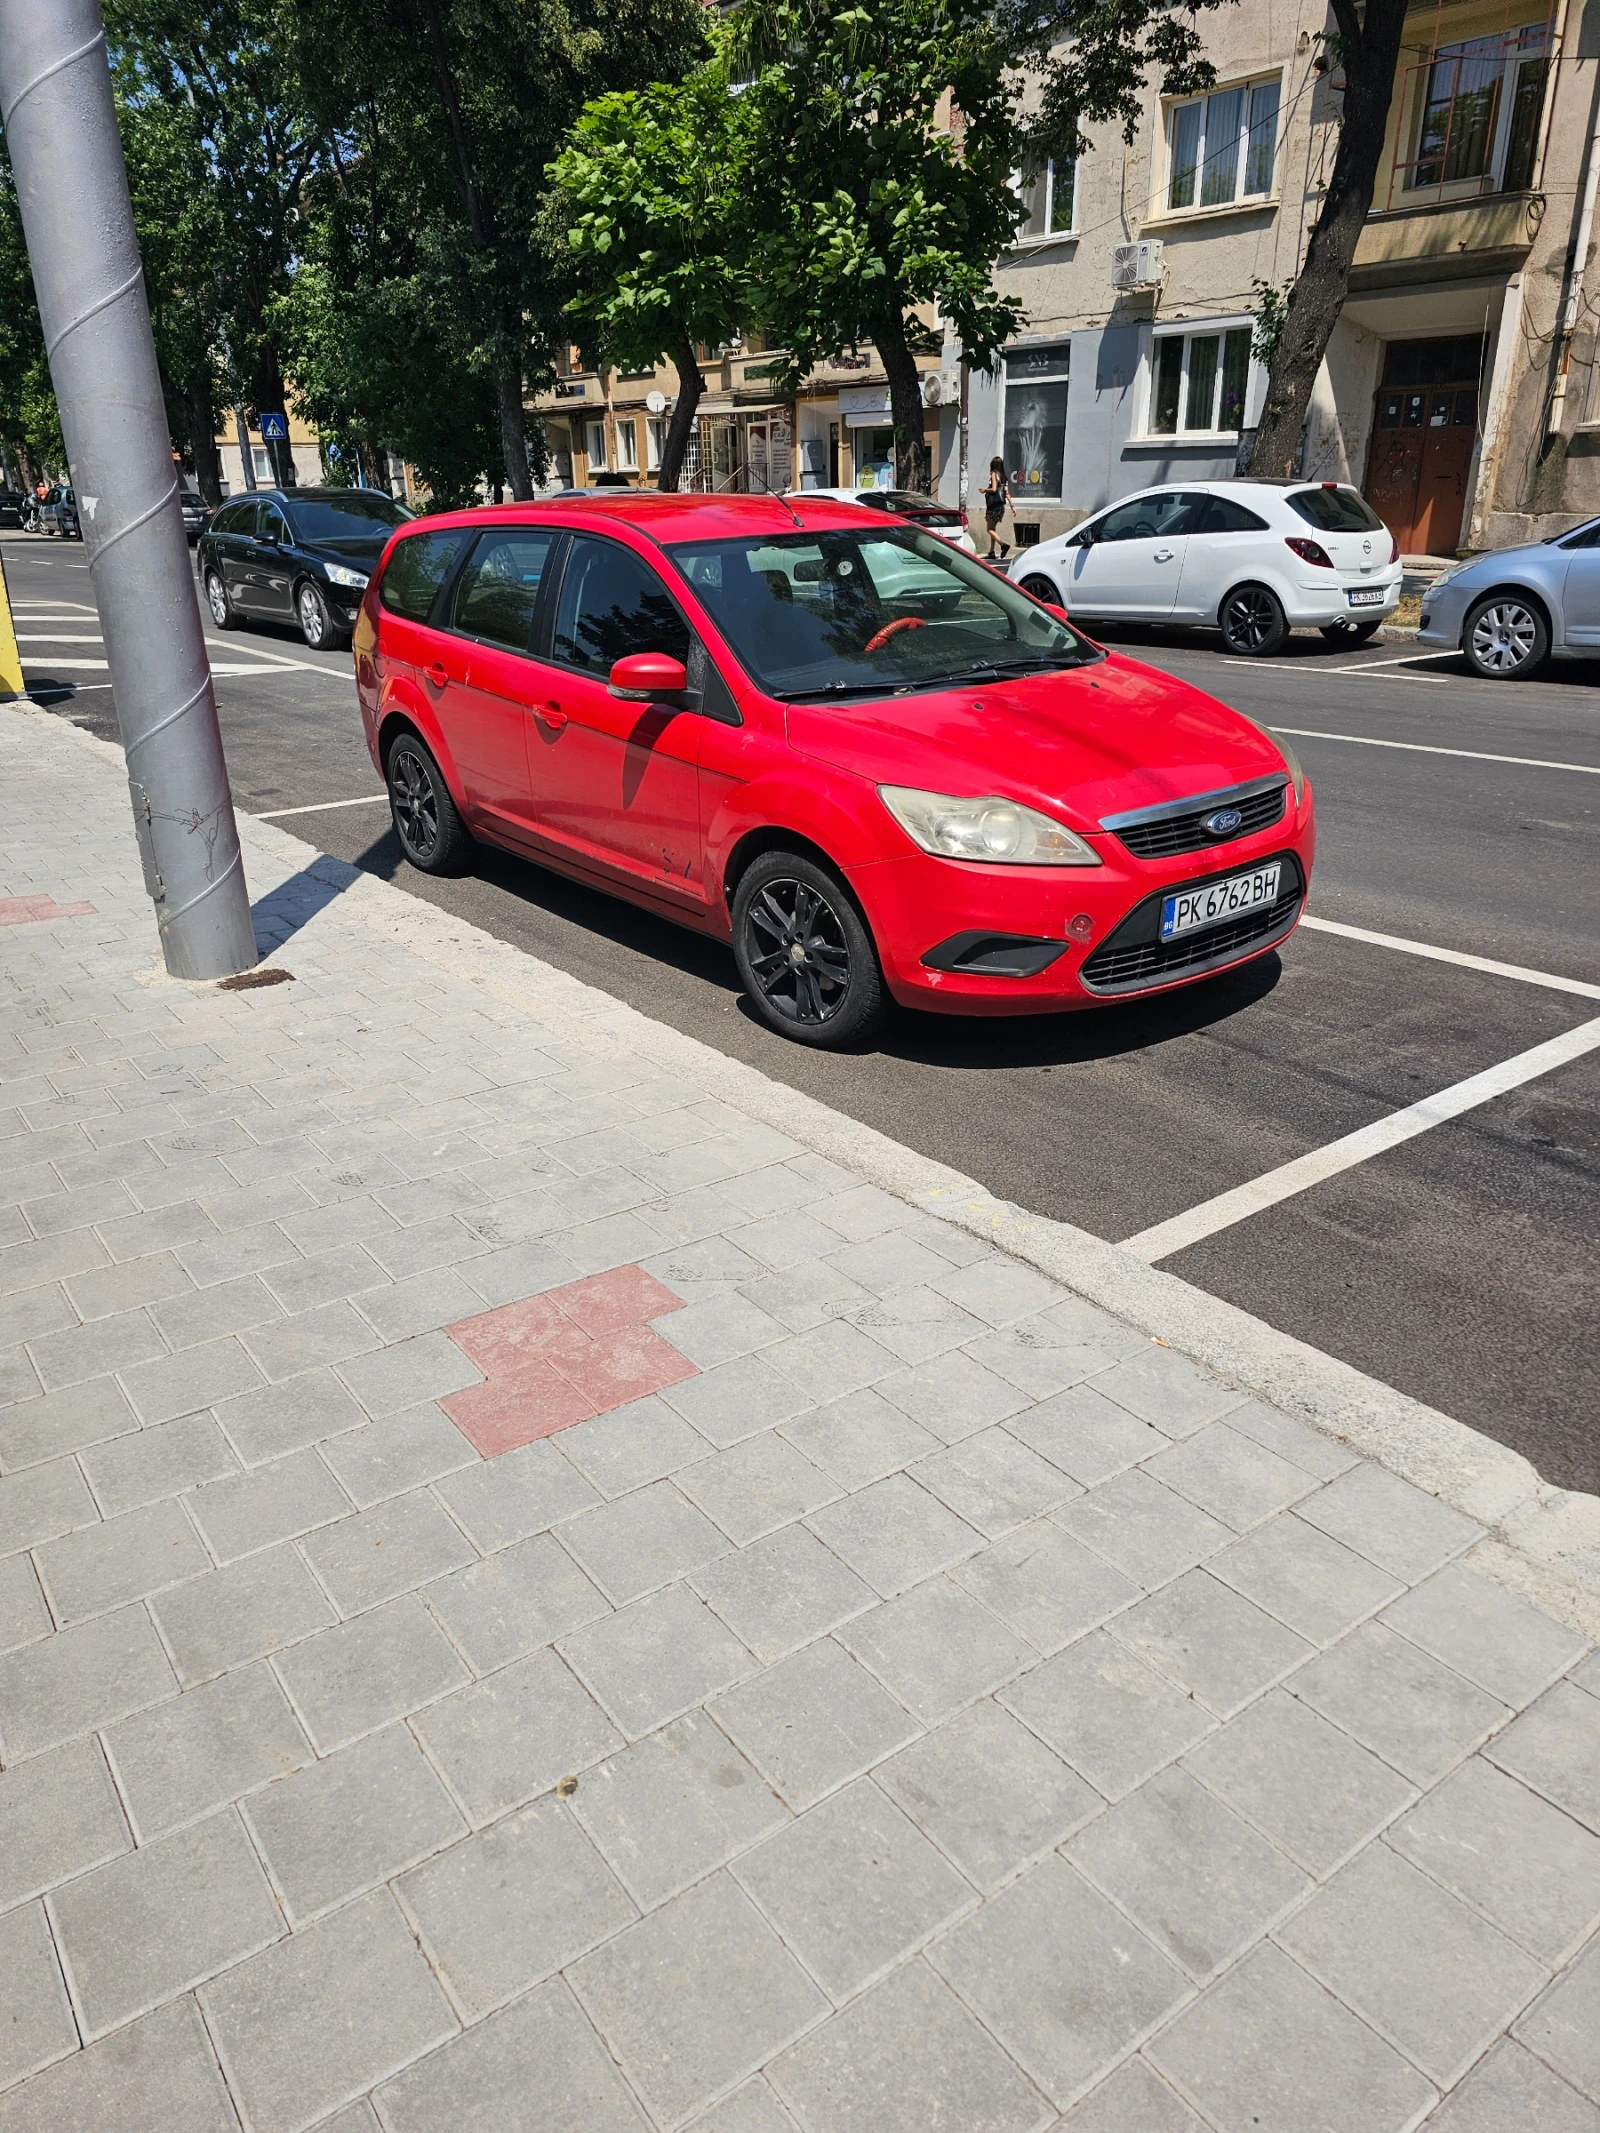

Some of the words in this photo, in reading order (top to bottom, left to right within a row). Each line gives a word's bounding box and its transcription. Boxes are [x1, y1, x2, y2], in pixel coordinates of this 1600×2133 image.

[1010, 469, 1049, 484] COLOR
[1218, 814, 1237, 830] Ford
[1177, 893, 1203, 928] PK
[1206, 879, 1250, 917] 6762
[1252, 870, 1277, 902] BH
[1164, 920, 1174, 931] BG
